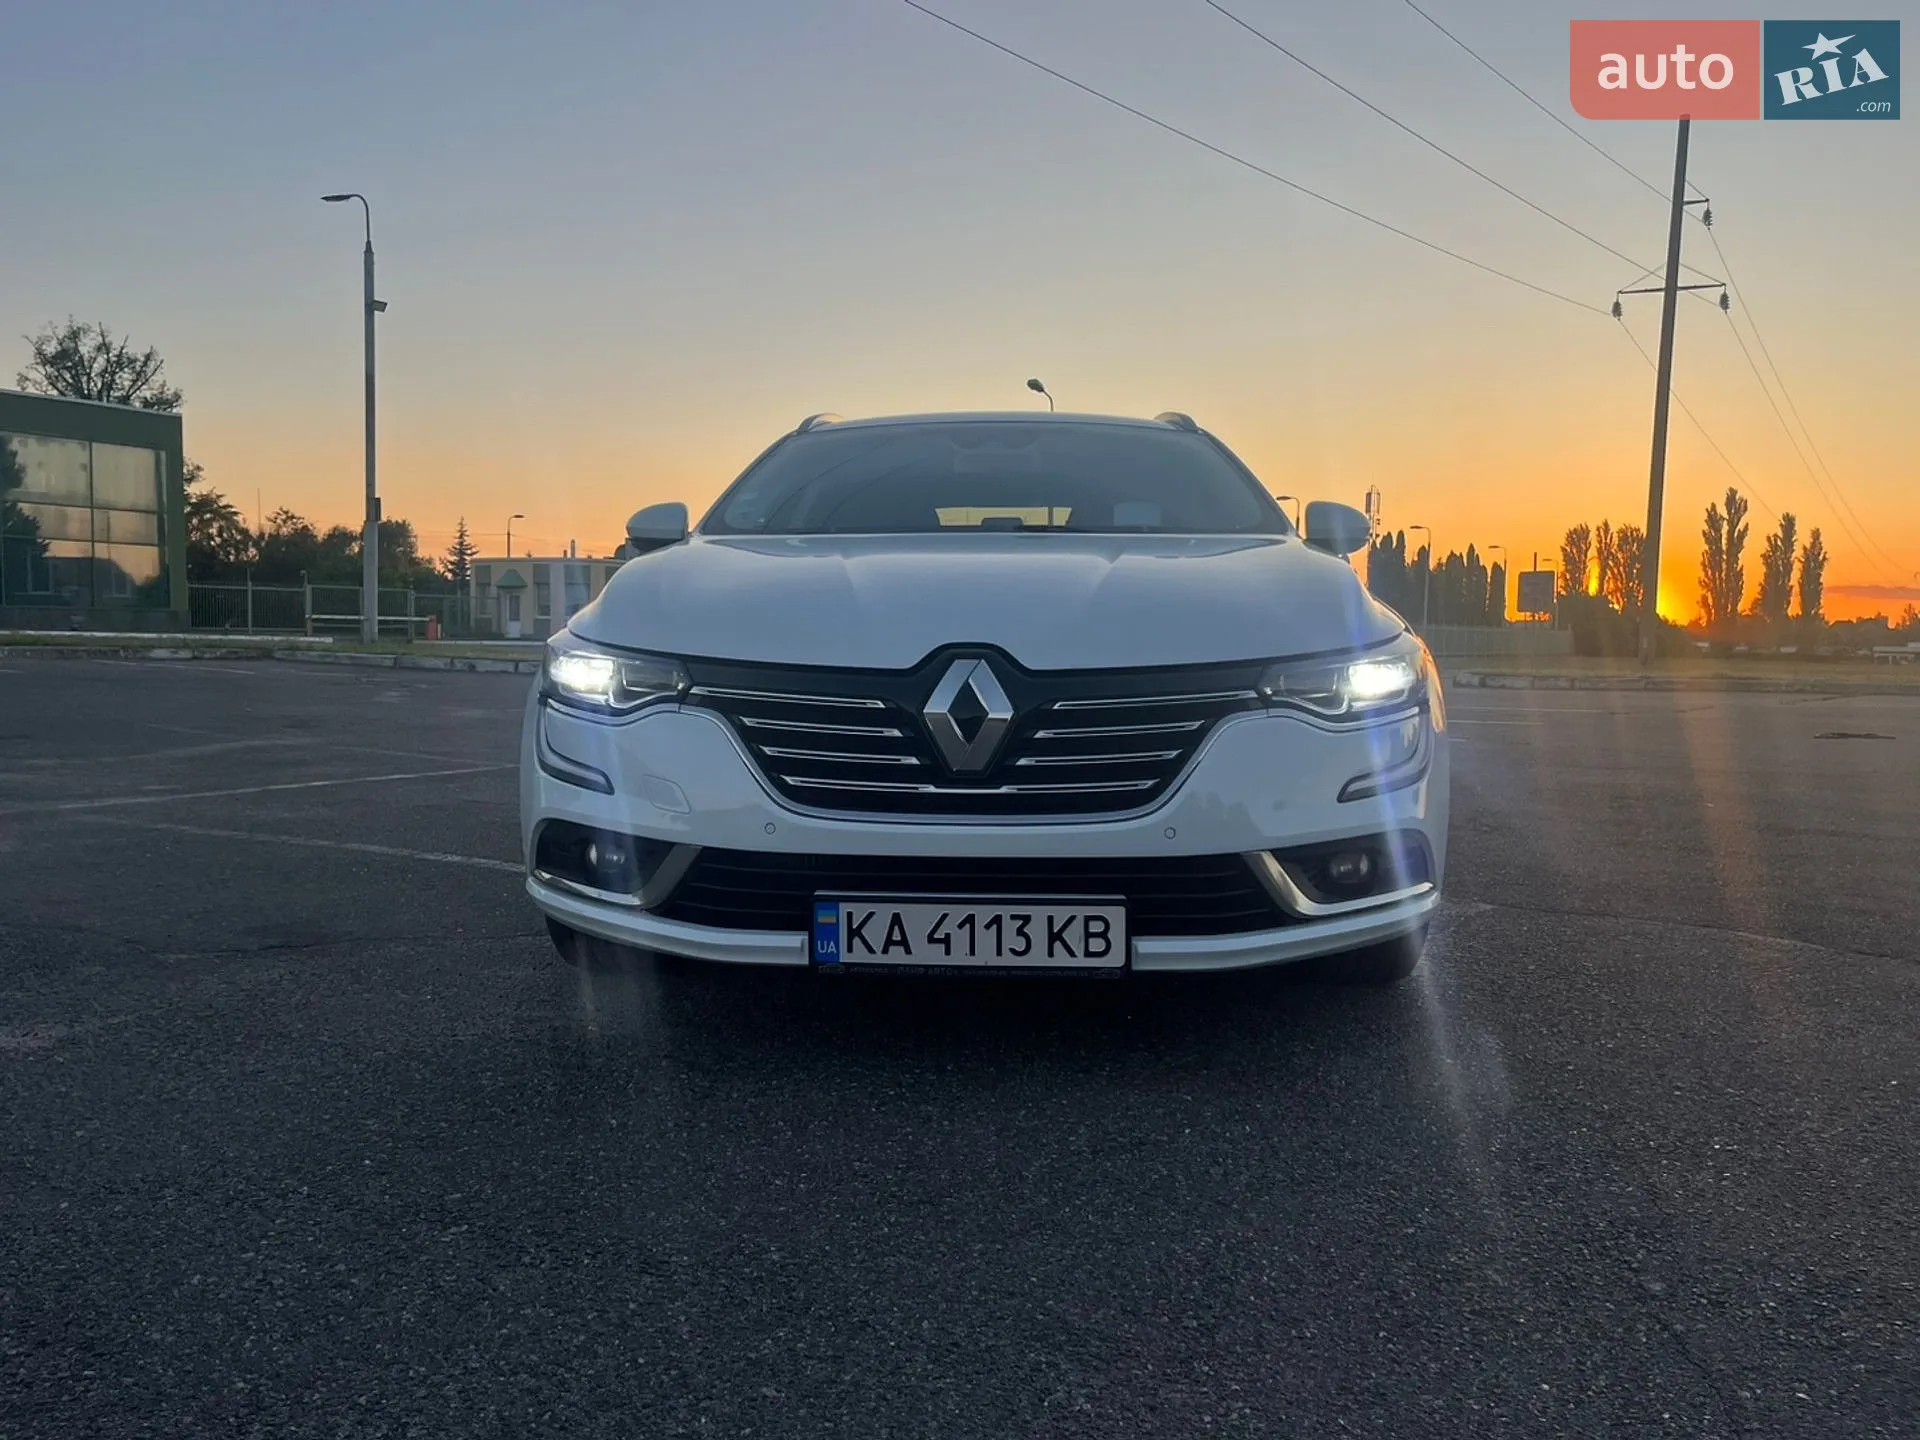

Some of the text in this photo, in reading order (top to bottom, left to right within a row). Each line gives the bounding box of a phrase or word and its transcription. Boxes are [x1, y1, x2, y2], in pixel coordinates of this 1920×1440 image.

[817, 939, 836, 954] UA
[846, 911, 1112, 958] KA 4113 KB
